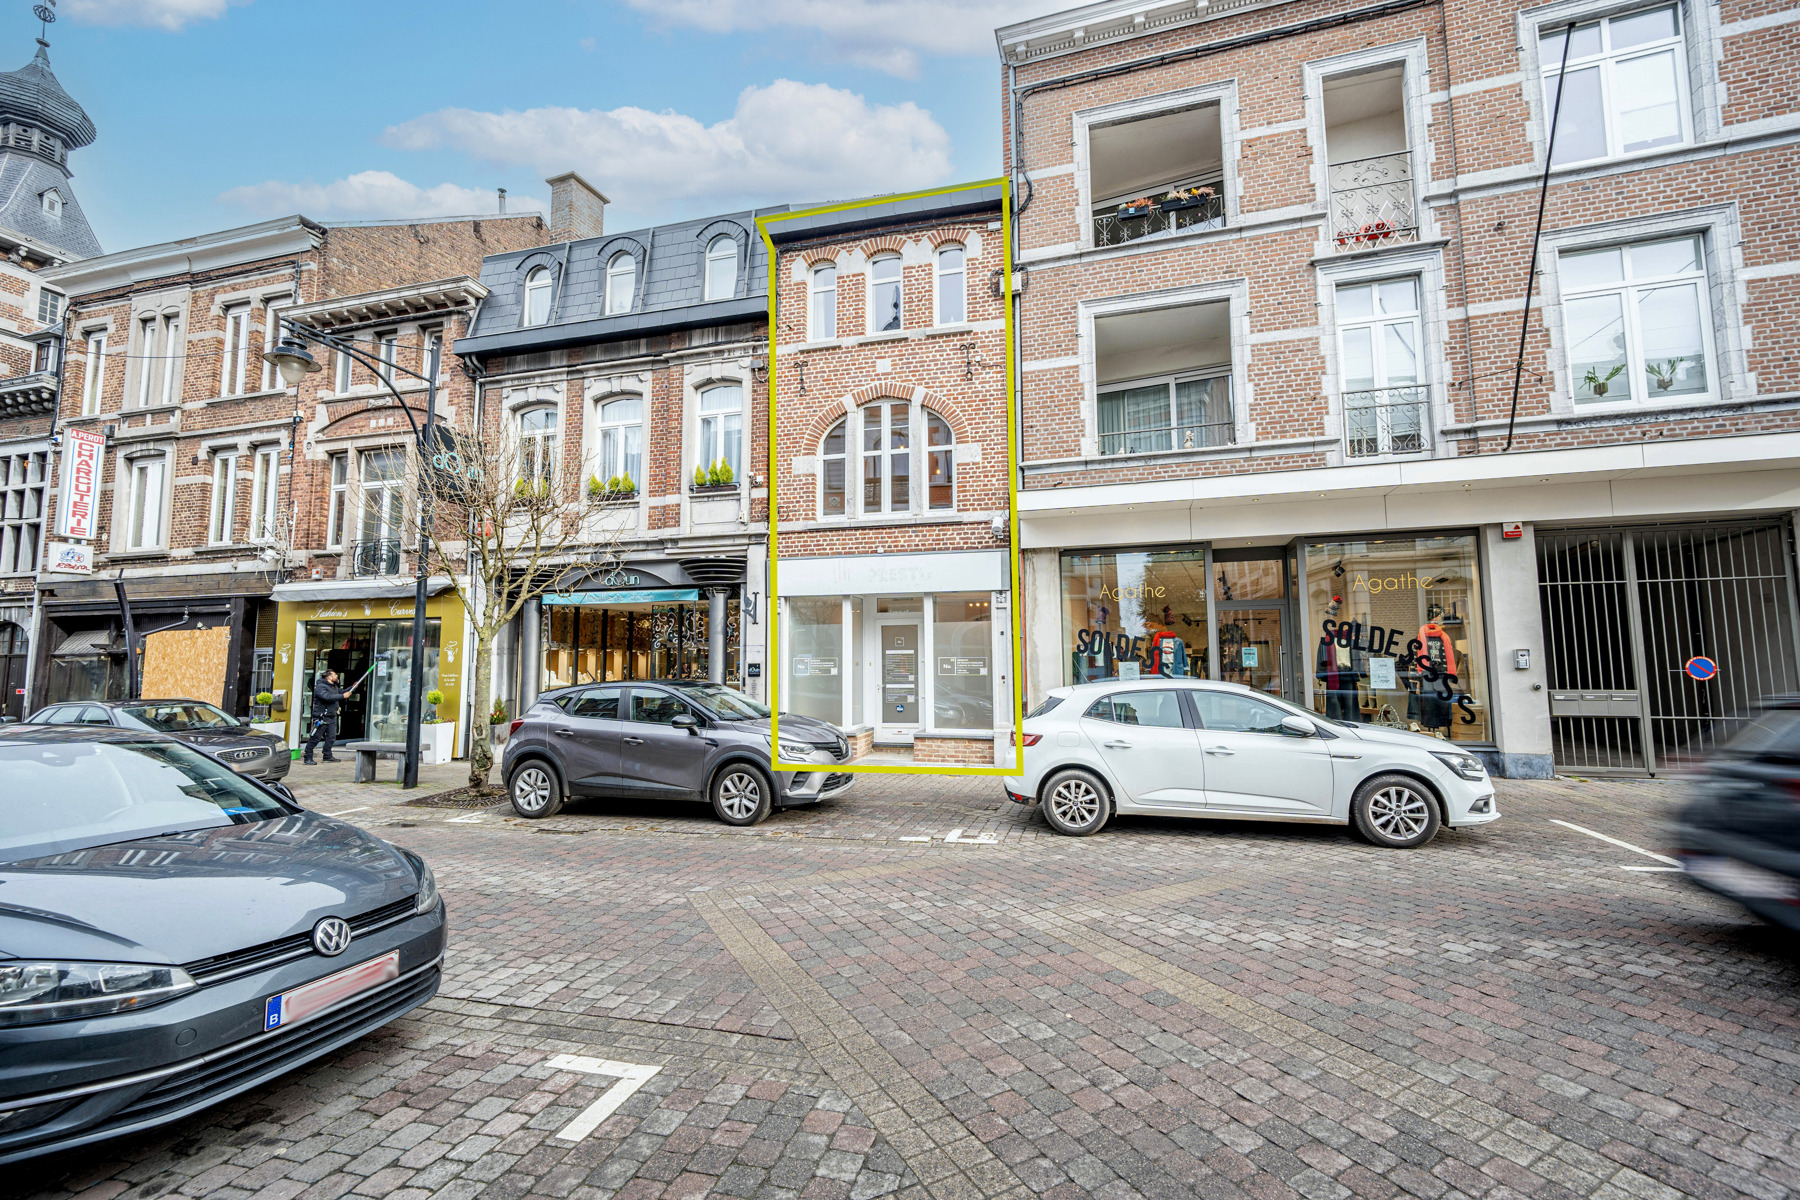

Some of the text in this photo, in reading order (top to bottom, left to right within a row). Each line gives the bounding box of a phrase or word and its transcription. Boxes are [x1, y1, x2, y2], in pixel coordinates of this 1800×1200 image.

[71, 430, 104, 445] A.PEROT
[70, 442, 95, 536] CHARCUTERIE
[1099, 582, 1166, 602] Agathe
[1353, 572, 1434, 594] Agathe
[310, 601, 349, 619] Fashion's
[269, 1013, 279, 1026] B
